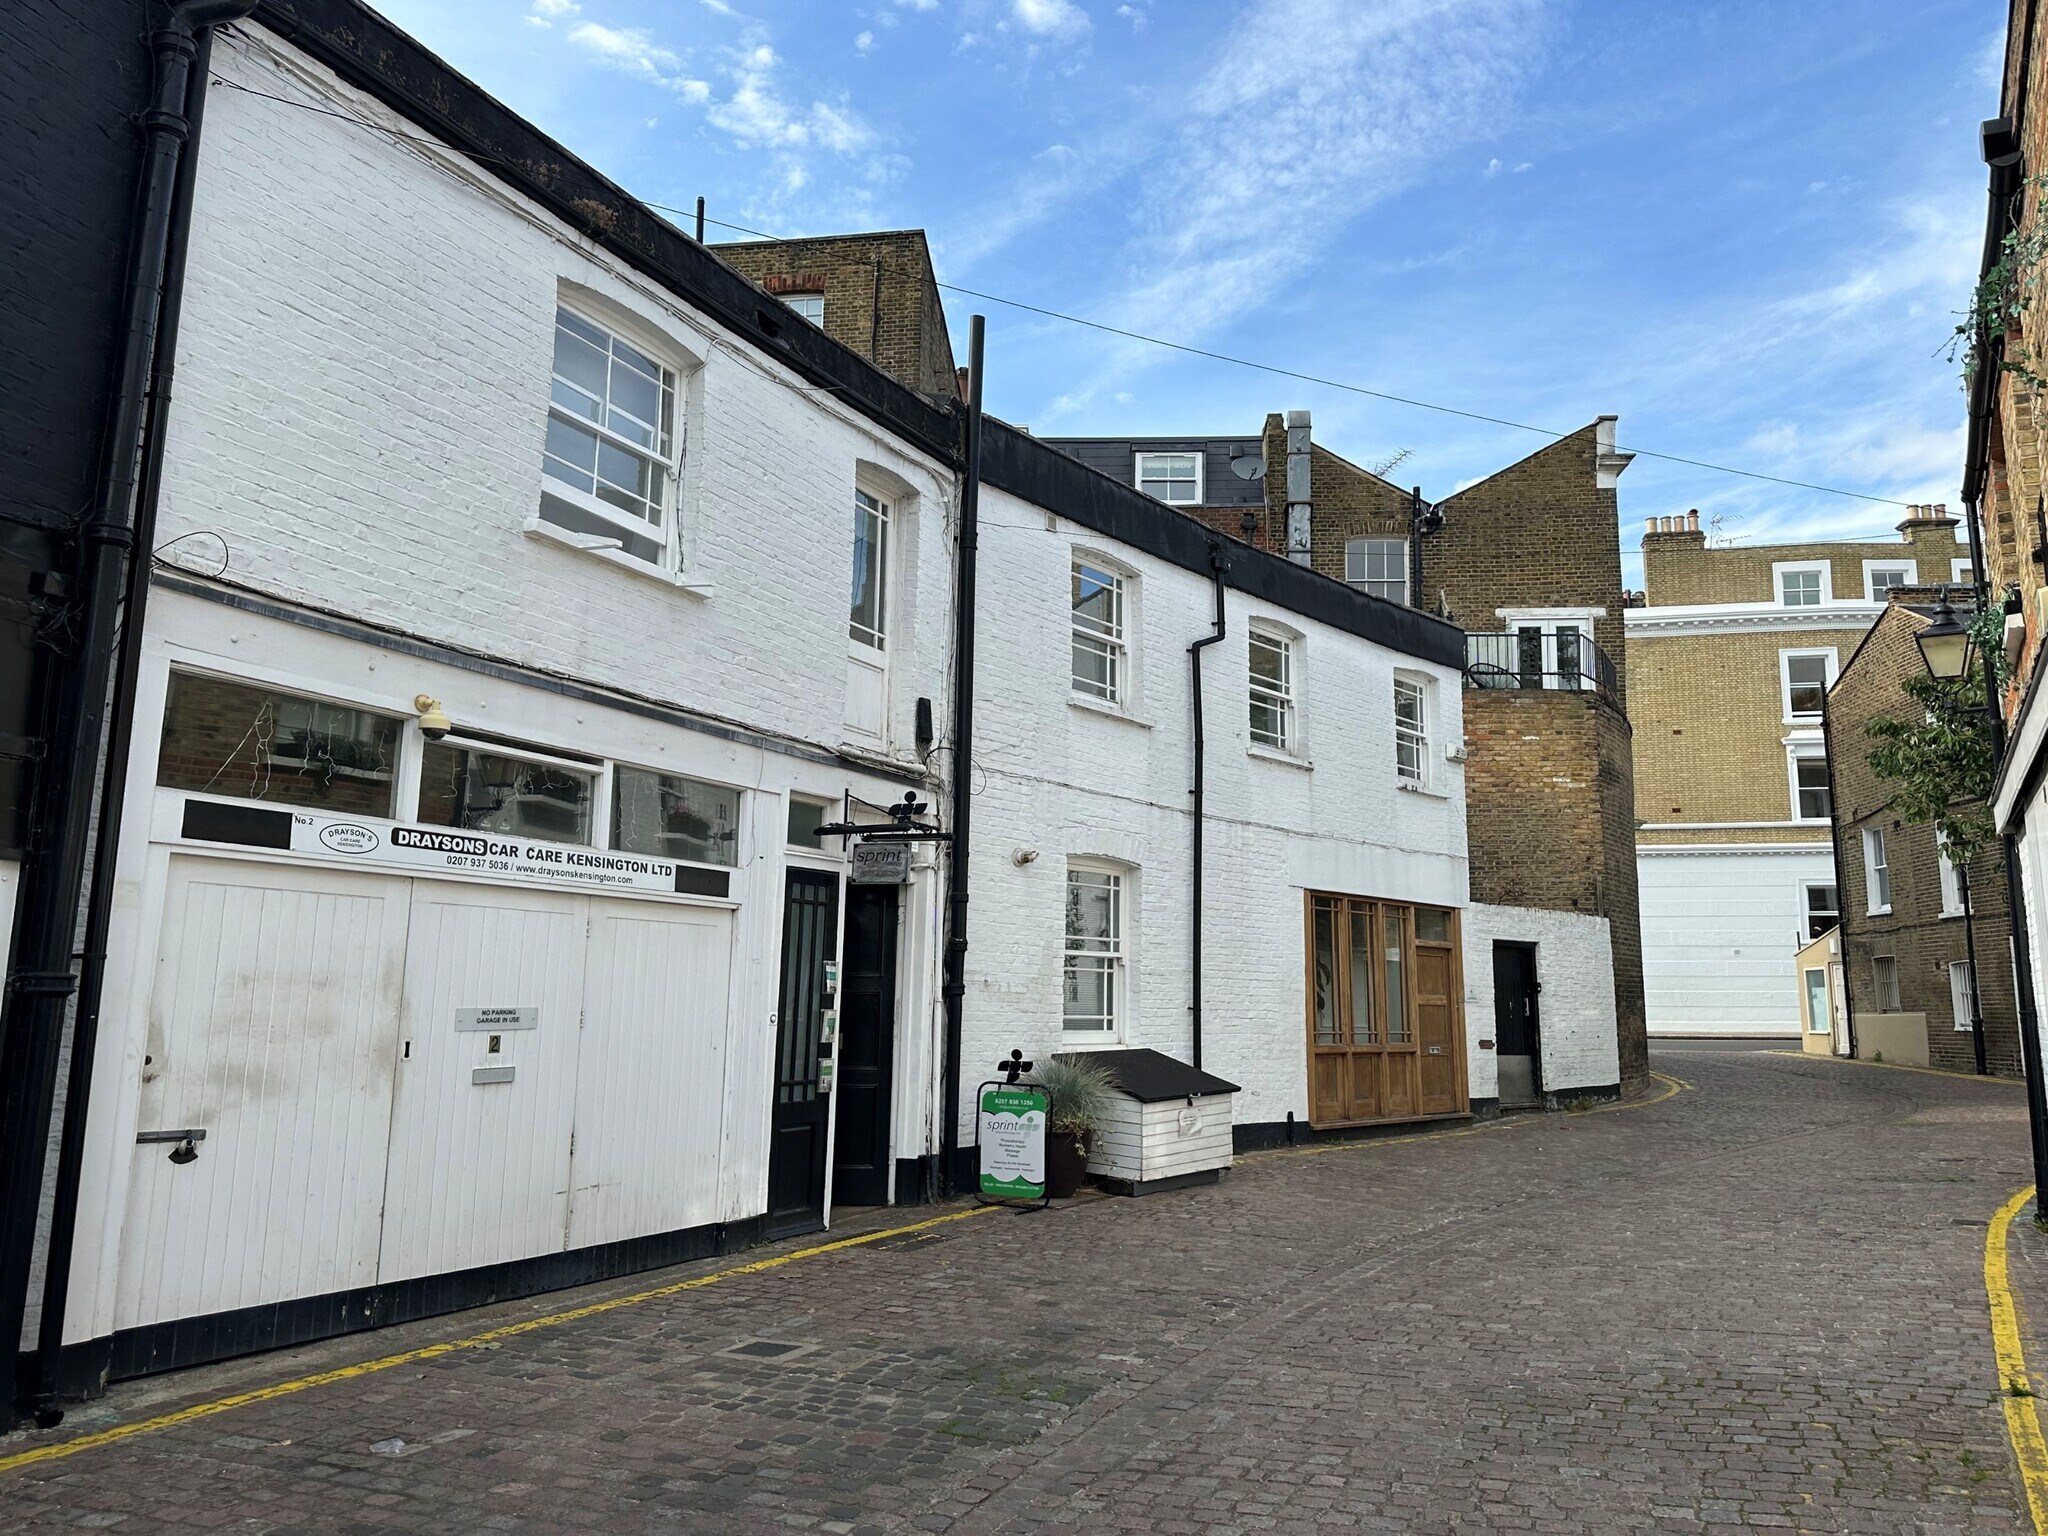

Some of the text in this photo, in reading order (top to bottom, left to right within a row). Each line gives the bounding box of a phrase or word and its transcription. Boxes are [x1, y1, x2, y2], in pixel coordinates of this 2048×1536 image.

[328, 828, 373, 842] DRAYSON'S
[398, 830, 673, 877] DRAYSONS CAR CARE KENSINGTON LTD
[856, 848, 902, 865] sprint
[446, 855, 468, 866] 0207
[470, 858, 486, 868] 937
[488, 860, 509, 871] 5036
[515, 863, 633, 885] www.draysonskensington.com
[490, 1036, 499, 1052] 2
[987, 1120, 1018, 1132] sprint
